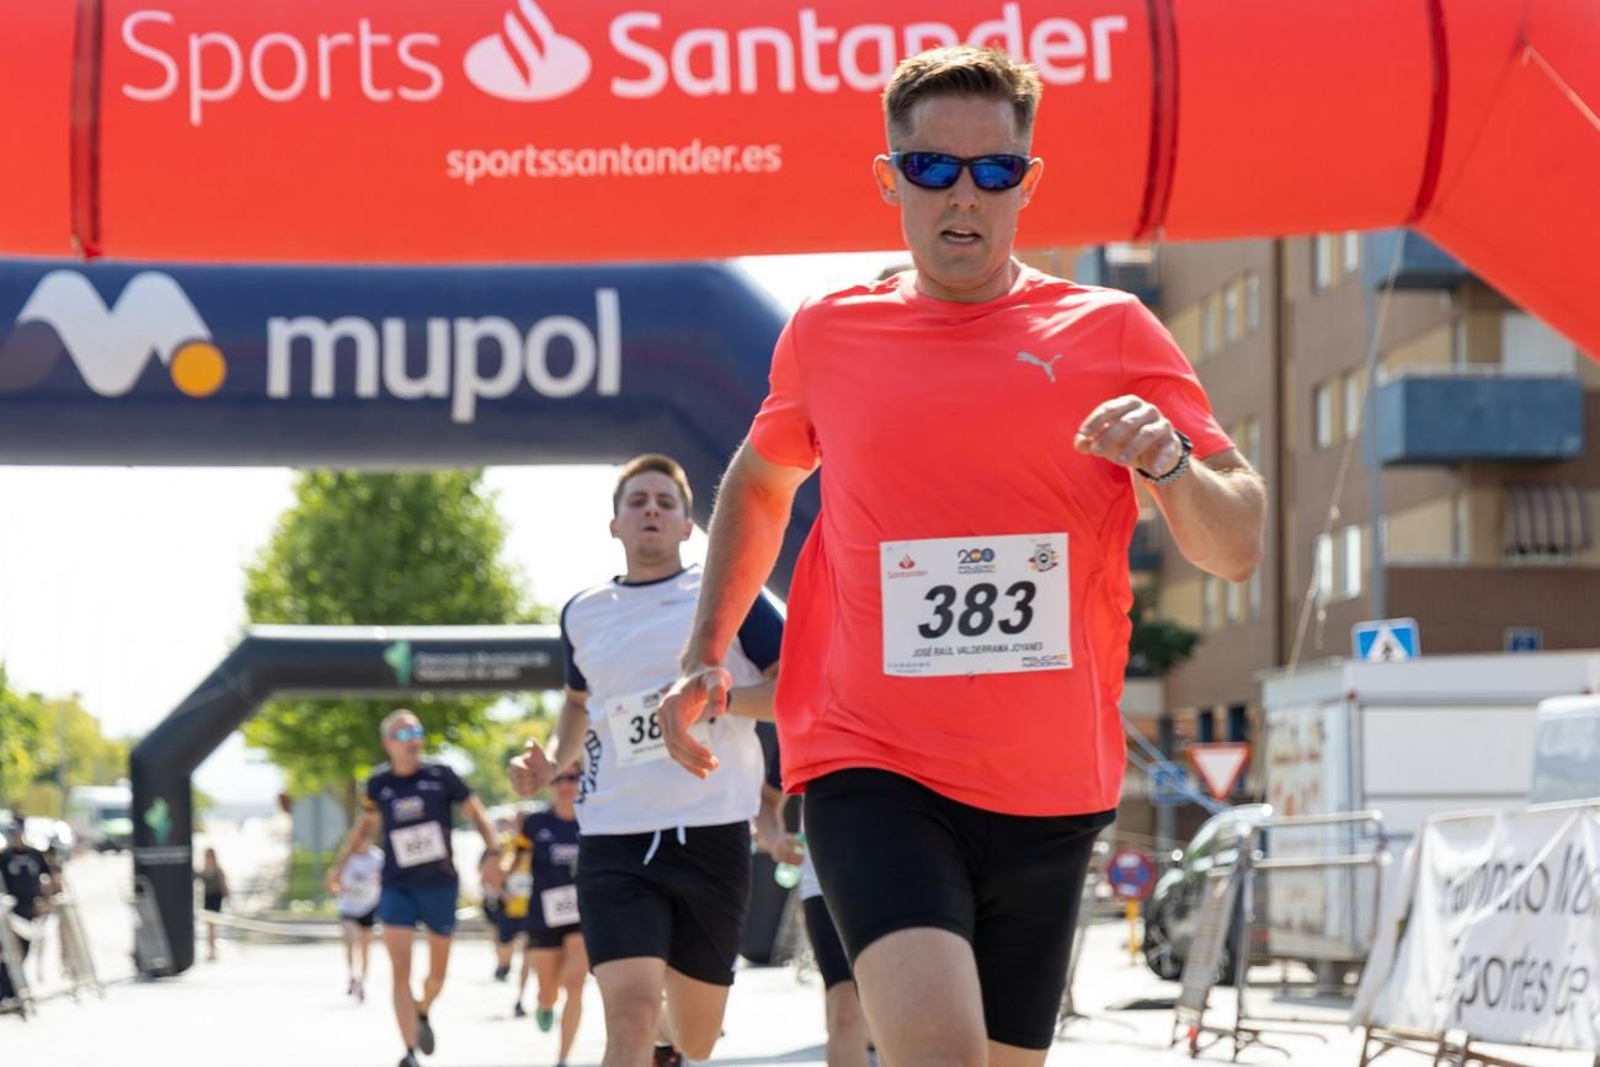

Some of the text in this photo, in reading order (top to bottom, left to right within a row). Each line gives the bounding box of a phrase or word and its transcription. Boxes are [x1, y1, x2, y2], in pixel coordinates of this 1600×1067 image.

[121, 10, 443, 125] Sports
[446, 140, 782, 184] sportssantander.es
[267, 289, 621, 422] mupol
[918, 581, 1036, 639] 383
[629, 712, 664, 744] 38
